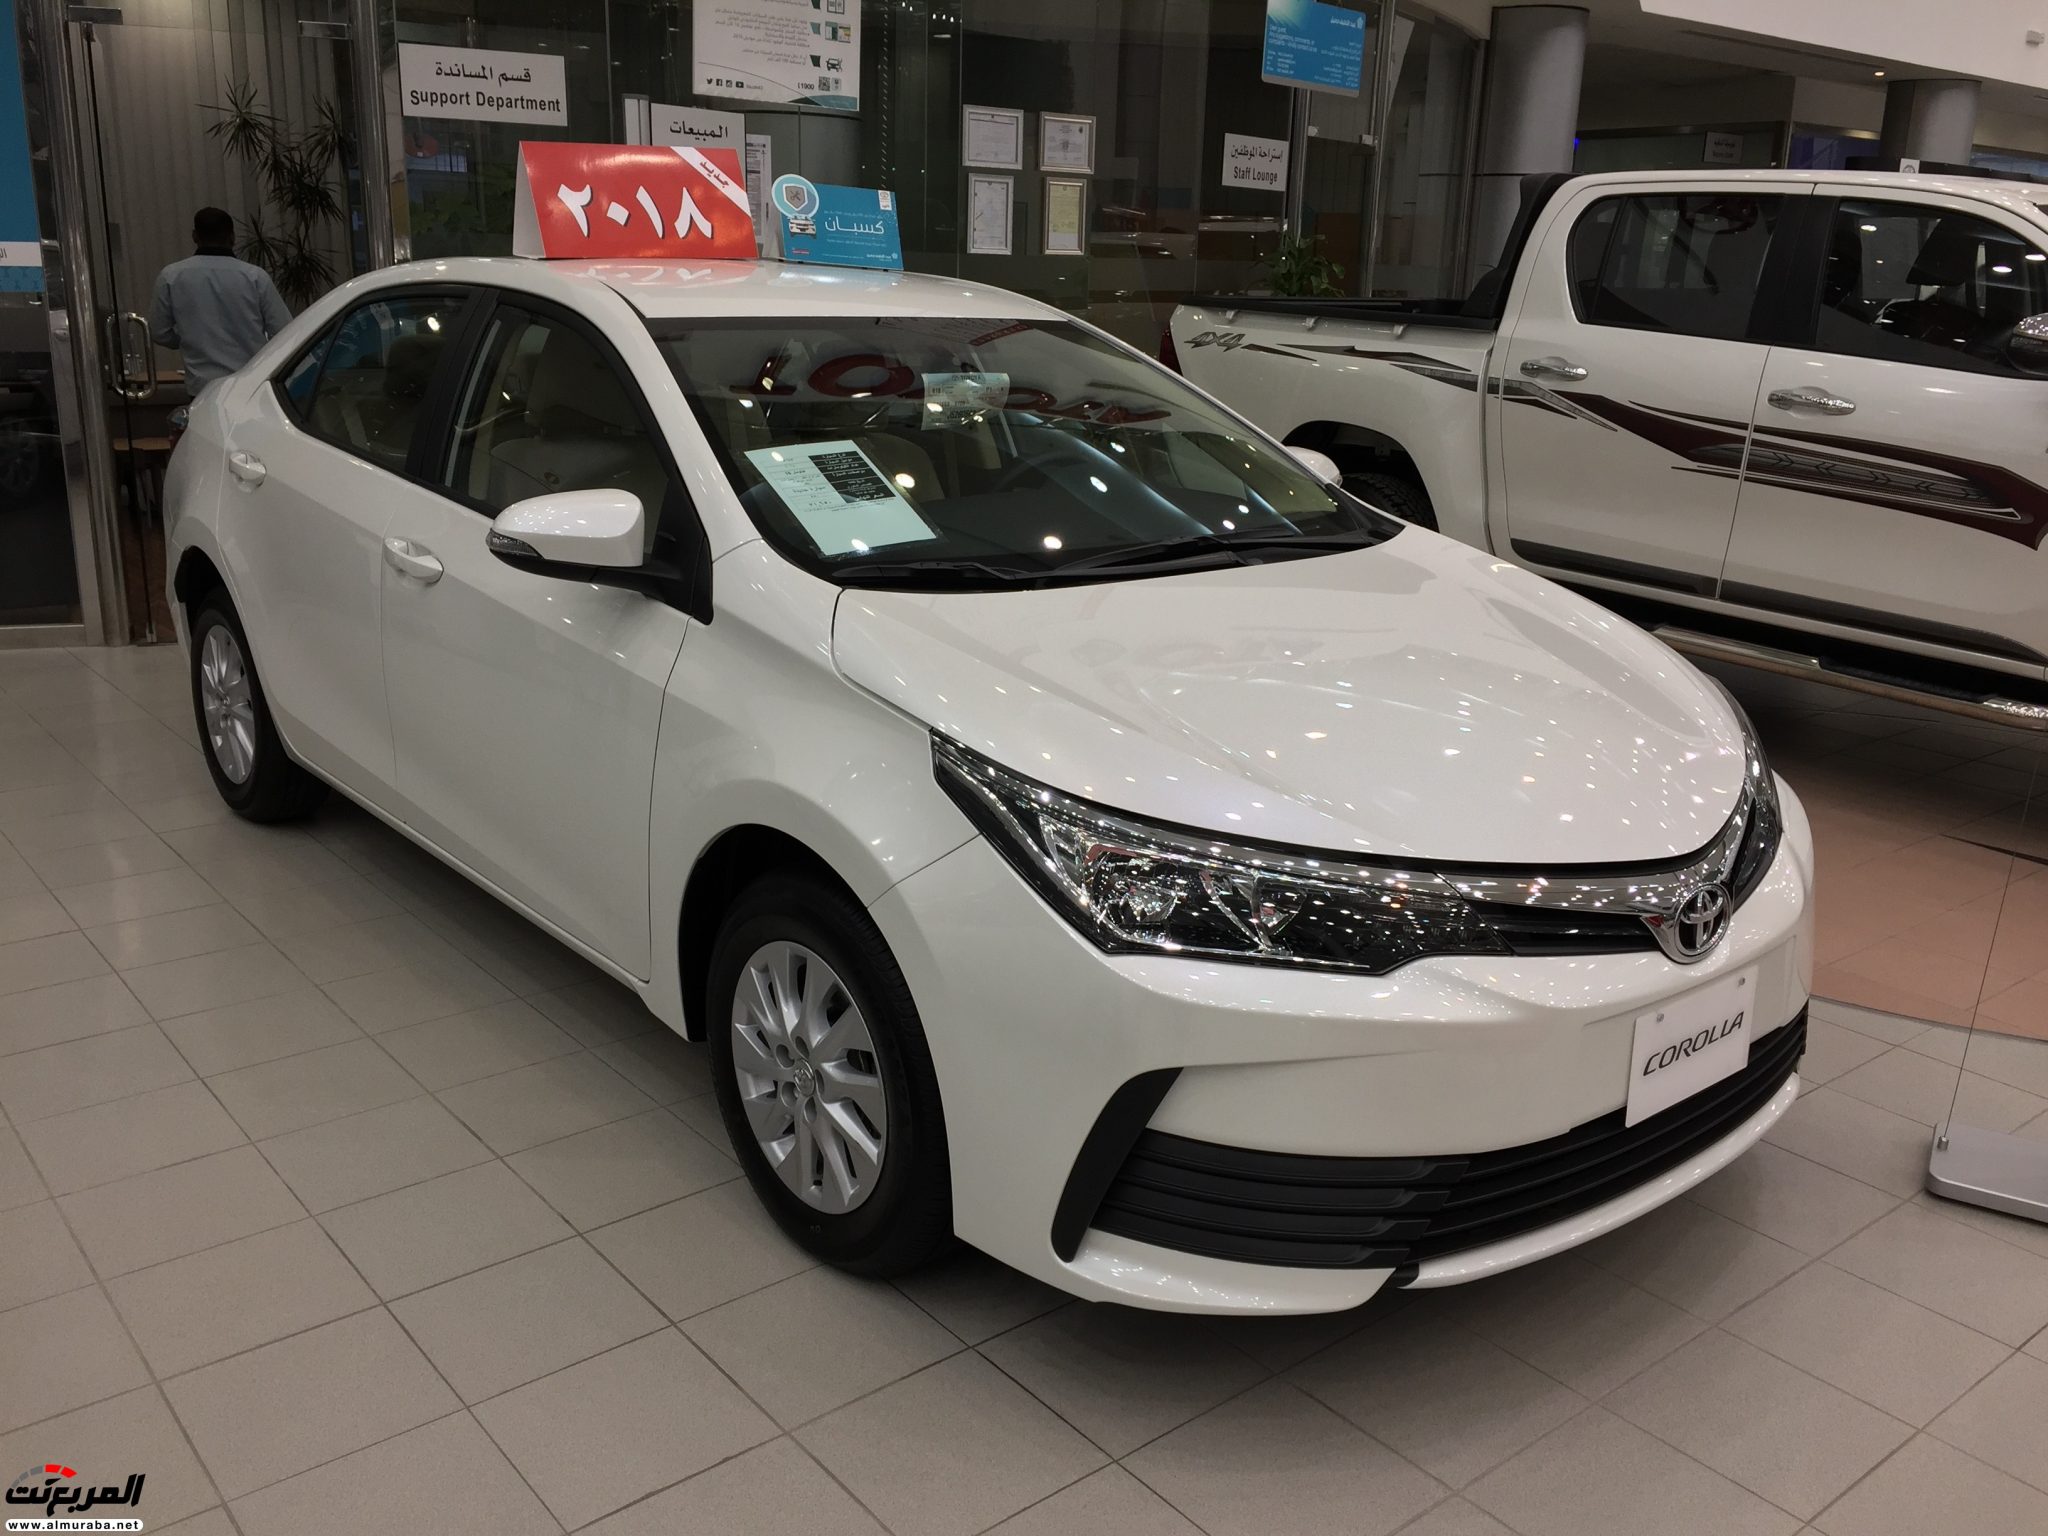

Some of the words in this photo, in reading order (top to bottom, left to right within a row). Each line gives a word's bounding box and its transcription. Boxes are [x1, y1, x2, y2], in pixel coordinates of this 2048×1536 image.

[435, 62, 493, 80] المساندة
[498, 68, 531, 87] قسم
[410, 90, 470, 107] Support
[476, 91, 561, 112] Department
[669, 121, 728, 141] المبيعات
[699, 160, 730, 188] جديد
[1233, 166, 1251, 180] Staff
[1252, 167, 1278, 185] Lounge
[557, 183, 713, 239] ٢٠١٨
[824, 216, 885, 235] كسبان
[1643, 1011, 1744, 1076] COROLLA
